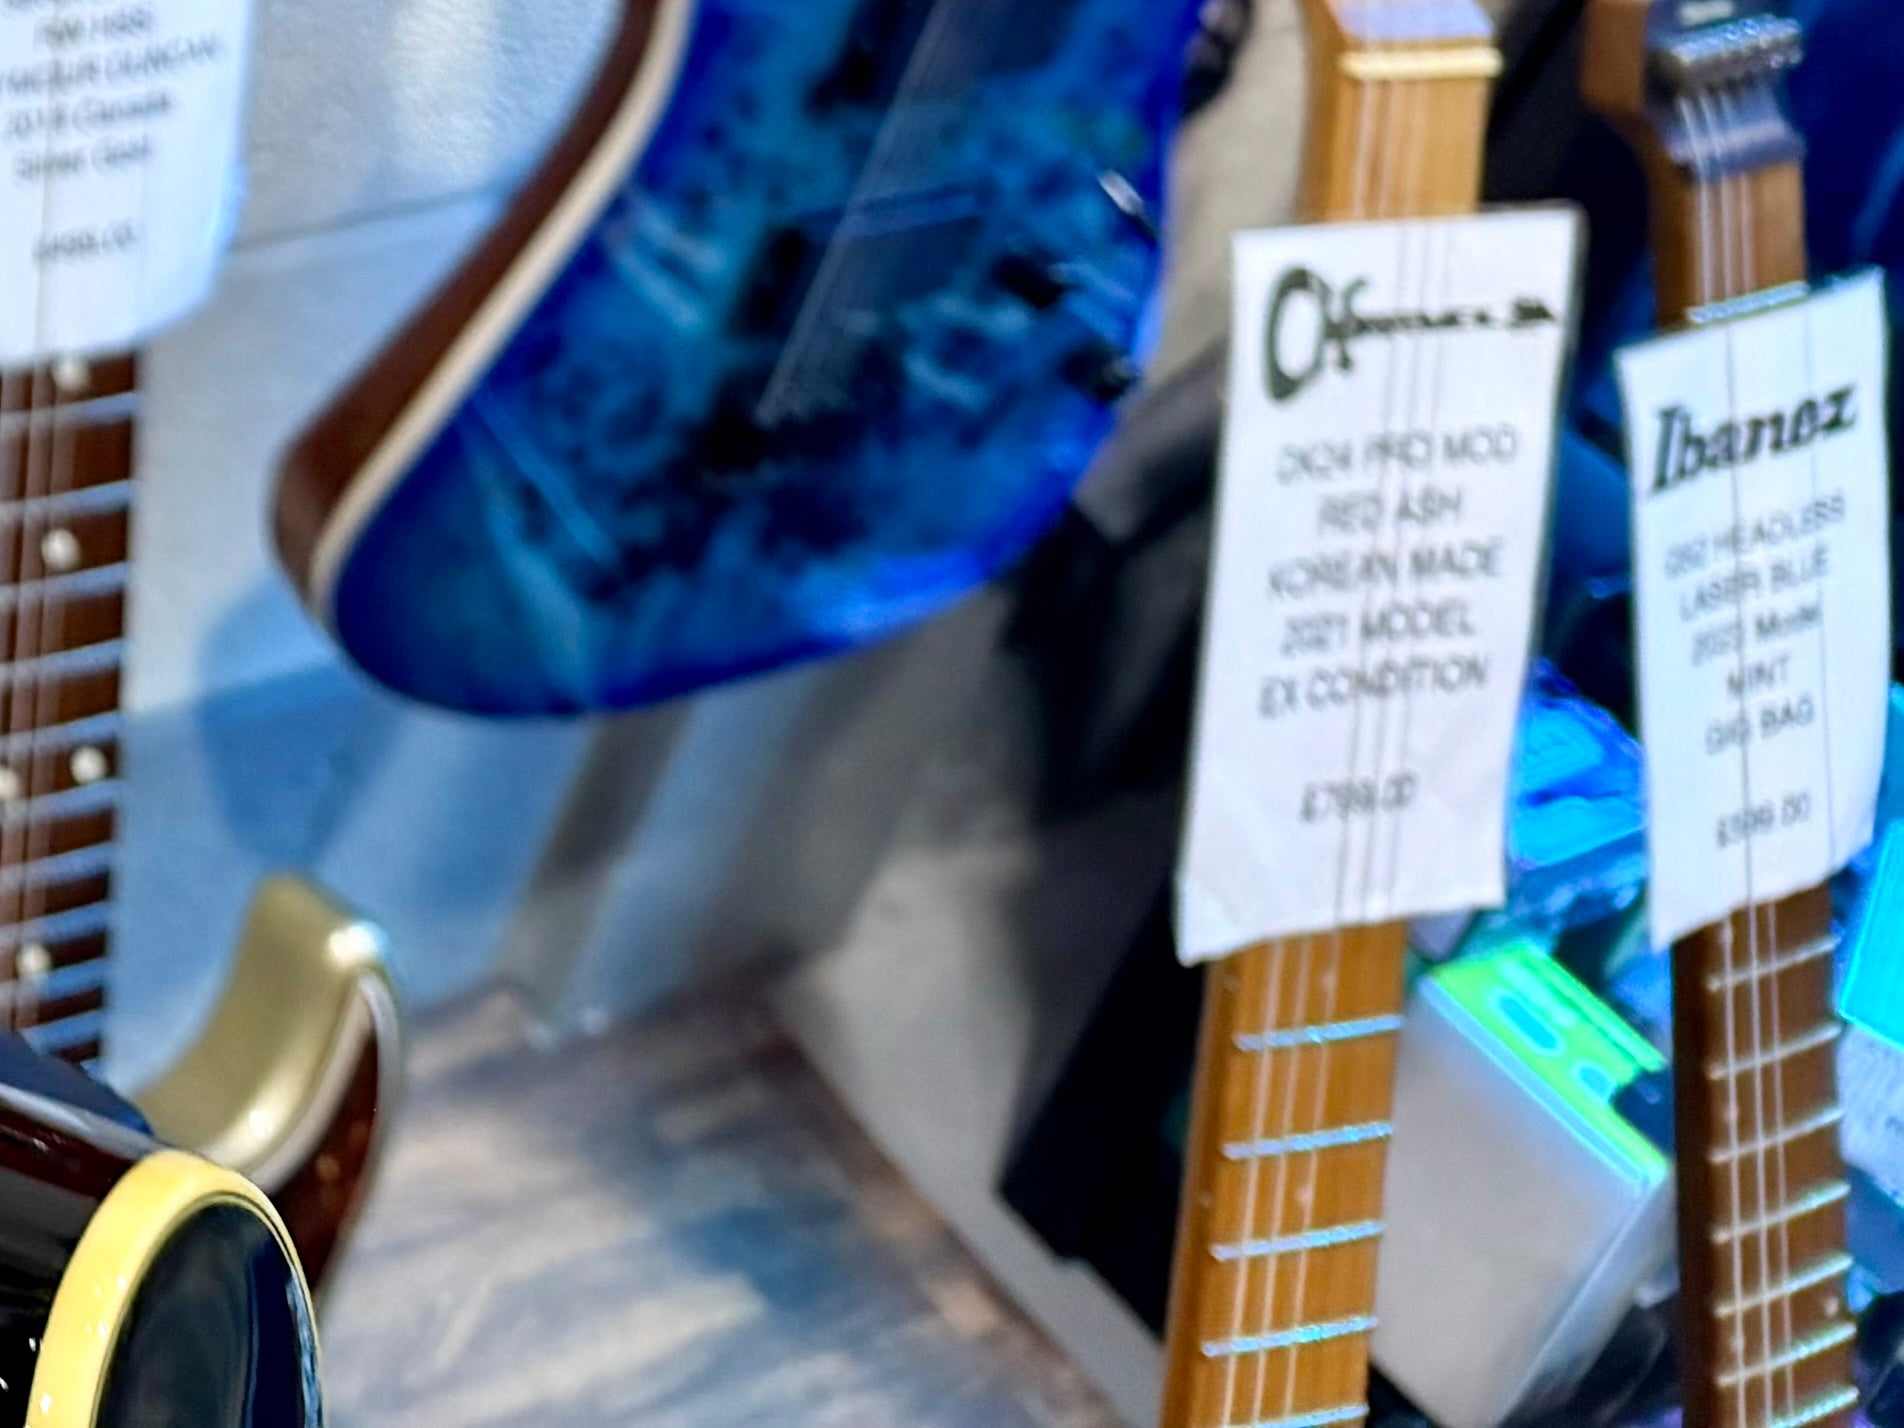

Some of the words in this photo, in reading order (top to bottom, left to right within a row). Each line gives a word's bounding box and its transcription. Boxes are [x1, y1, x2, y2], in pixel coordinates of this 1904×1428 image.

[1649, 382, 1859, 494] Ibanez
[1358, 600, 1478, 644] MODEL
[1305, 650, 1491, 712] CONDITION
